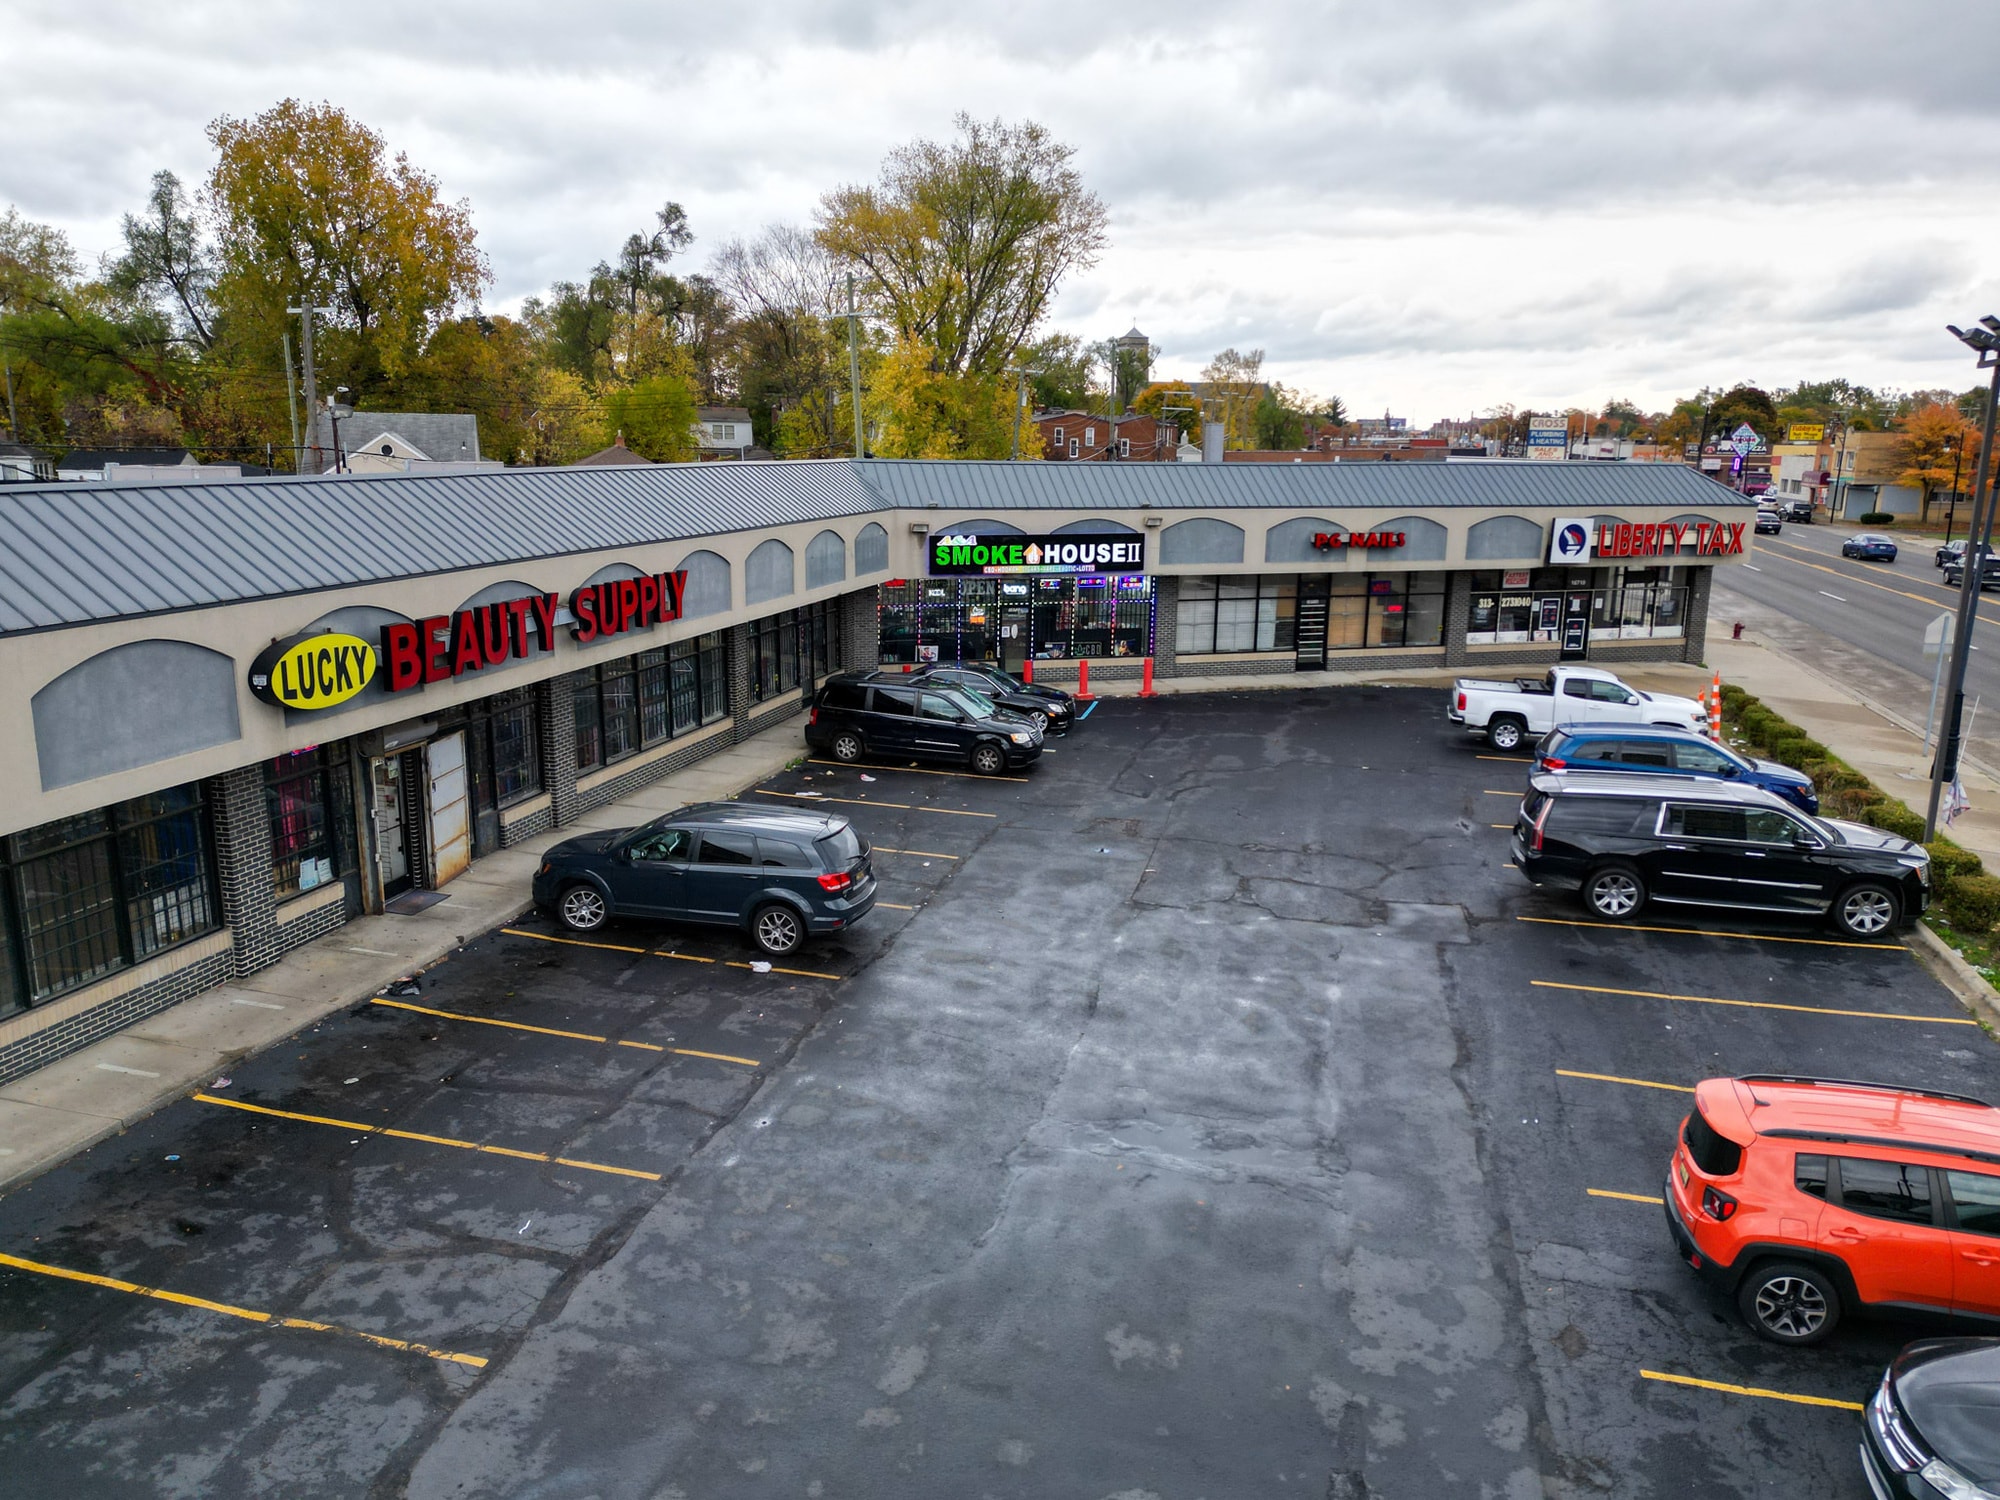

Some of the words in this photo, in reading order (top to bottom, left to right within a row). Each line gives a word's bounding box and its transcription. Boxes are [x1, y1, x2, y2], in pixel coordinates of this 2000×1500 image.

[1532, 419, 1566, 428] CROSS
[1314, 533, 1342, 549] PG
[1349, 532, 1406, 549] NAILS
[1598, 523, 1689, 557] LIBERTY
[1696, 522, 1746, 556] TAX
[936, 545, 1024, 566] SMOKE
[1044, 543, 1127, 565] HOUSE
[381, 592, 559, 692] BEAUTY
[570, 570, 688, 643] SUPPLY
[1085, 645, 1101, 655] CBD
[280, 645, 368, 701] LUCKY
